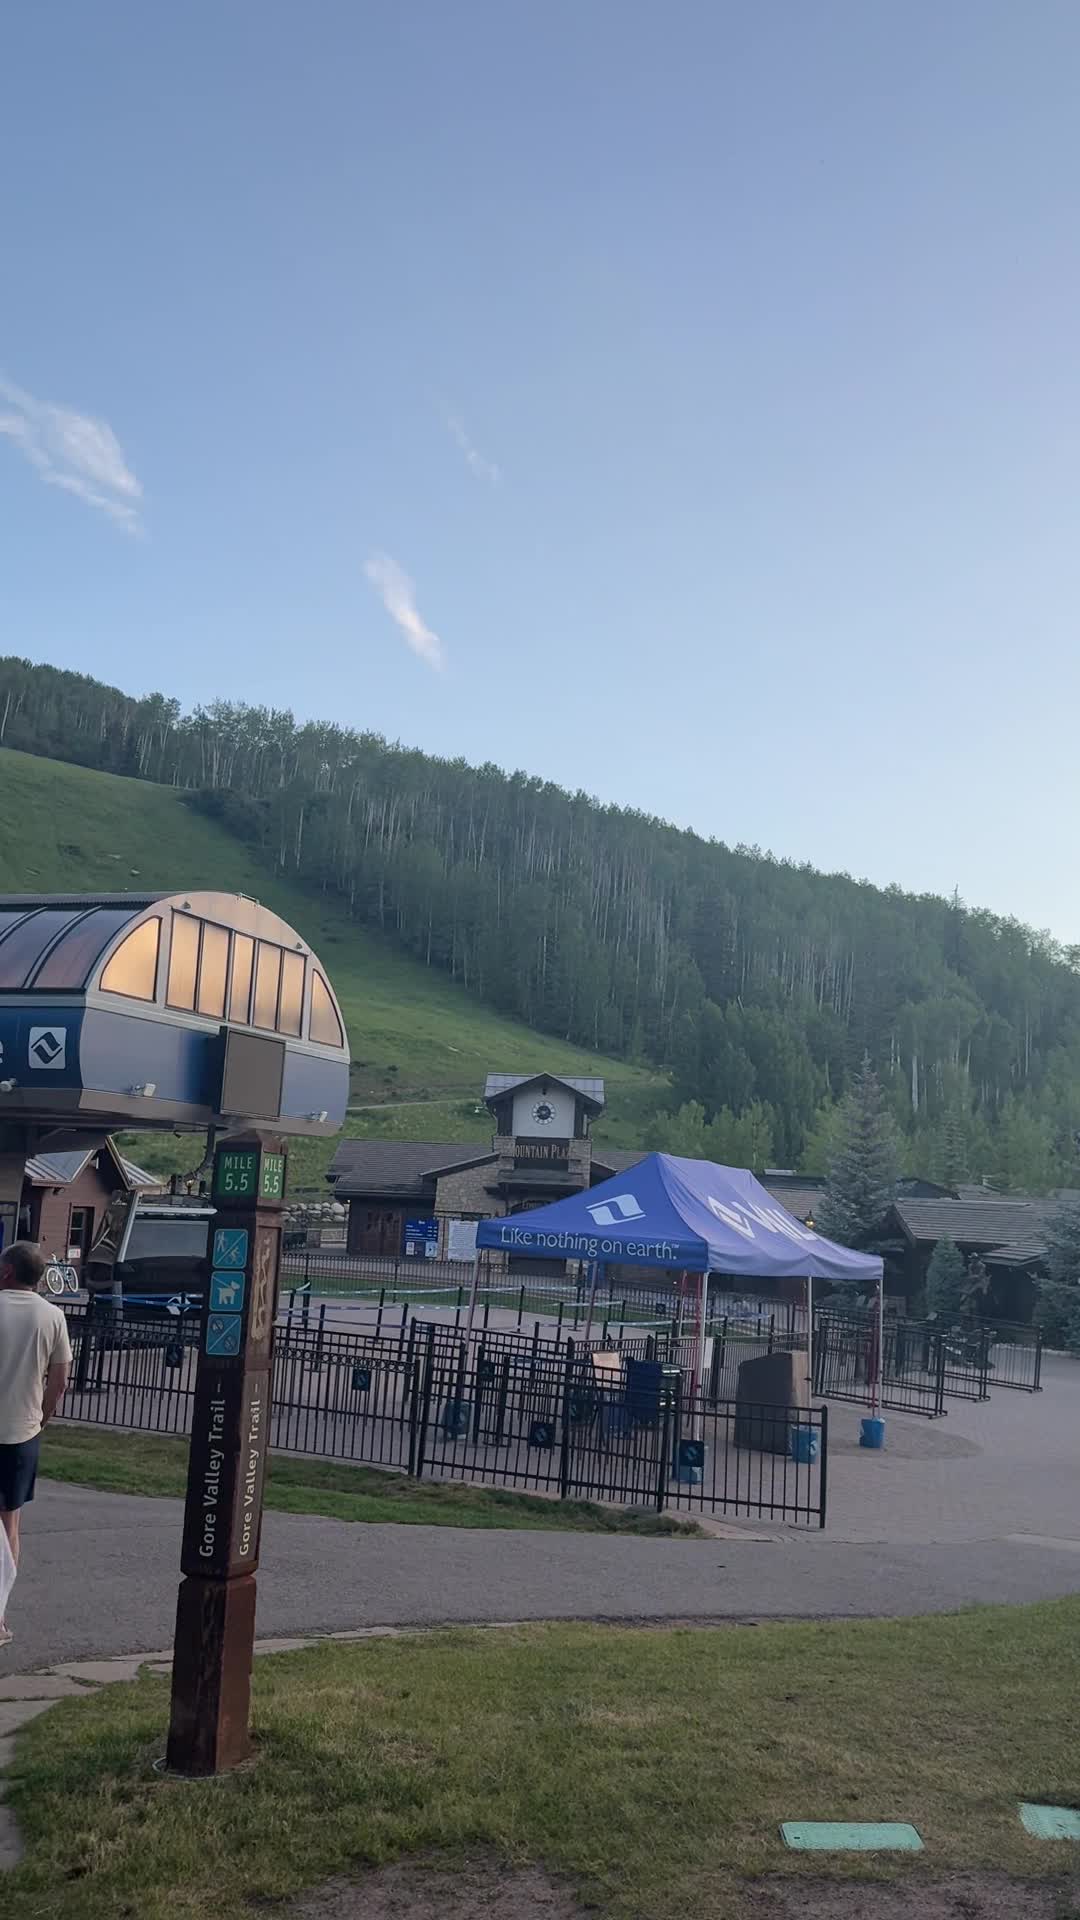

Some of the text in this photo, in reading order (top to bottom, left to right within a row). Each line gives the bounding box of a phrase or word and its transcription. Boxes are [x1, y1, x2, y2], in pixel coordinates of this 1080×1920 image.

[224, 1156, 253, 1169] MILE
[264, 1158, 282, 1172] MILE
[224, 1173, 248, 1191] 5.5
[264, 1174, 279, 1193] 5.5
[501, 1226, 532, 1245] Like
[537, 1232, 598, 1257] nothing
[601, 1239, 622, 1254] on
[199, 1400, 225, 1557] Gore Valley Trail
[239, 1400, 261, 1555] Gore Valley Trail
